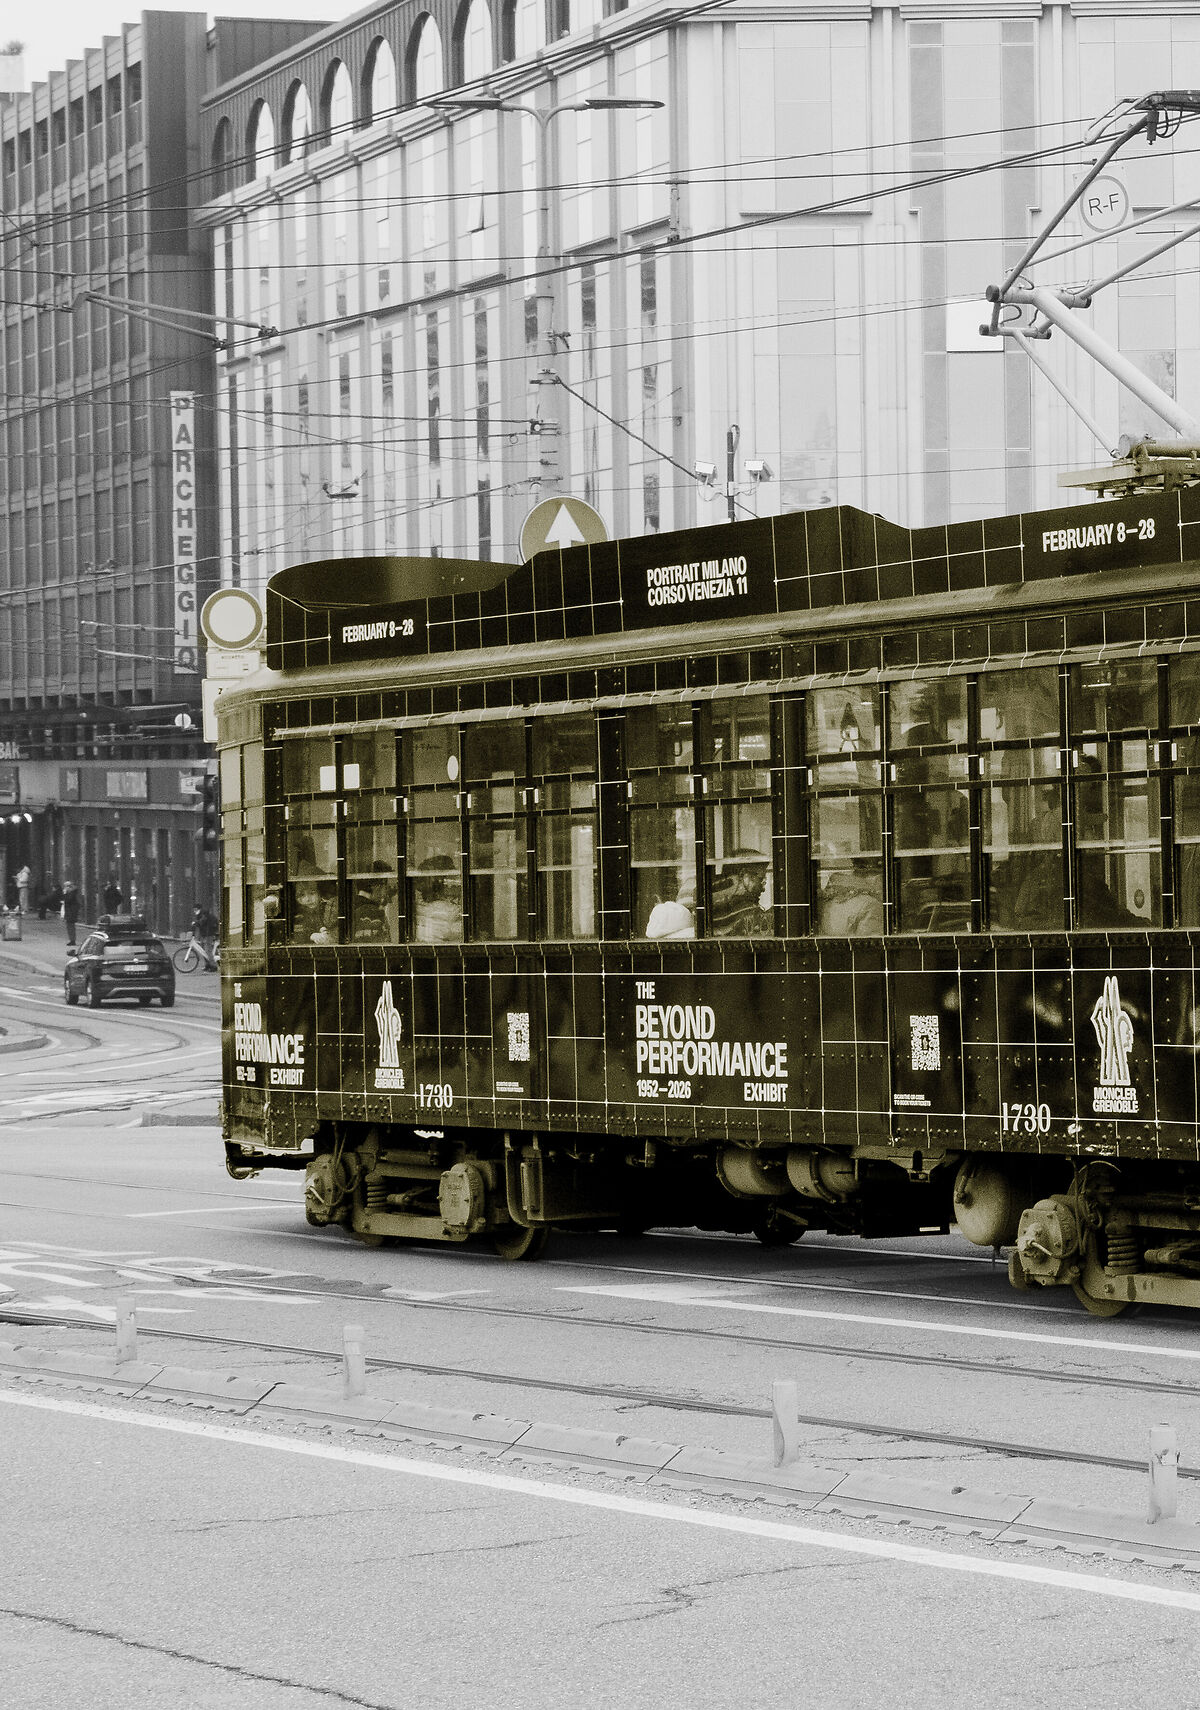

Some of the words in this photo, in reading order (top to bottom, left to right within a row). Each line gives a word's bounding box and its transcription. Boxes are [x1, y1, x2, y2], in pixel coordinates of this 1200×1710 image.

[1088, 192, 1119, 216] R-F
[173, 396, 196, 667] PARCHEGGIO
[1042, 522, 1114, 553] FEBRUARY
[646, 562, 700, 588] PORTRAIT
[701, 555, 748, 580] MILANO
[647, 583, 686, 607] CORSO
[685, 577, 735, 602] VENEZIA
[736, 576, 748, 595] 11
[342, 621, 389, 644] FEBRUARY
[635, 981, 656, 1000] THE
[635, 1004, 716, 1040] BEYOND
[636, 1040, 788, 1078] PERFORMANCE
[270, 1067, 305, 1086] EXHIBIT
[419, 1083, 454, 1109] 1730
[743, 1082, 788, 1103] EXHIBIT
[1092, 1086, 1137, 1101] MONCLER
[1001, 1102, 1051, 1133] 1730
[1092, 1100, 1140, 1114] GRENOBLE
